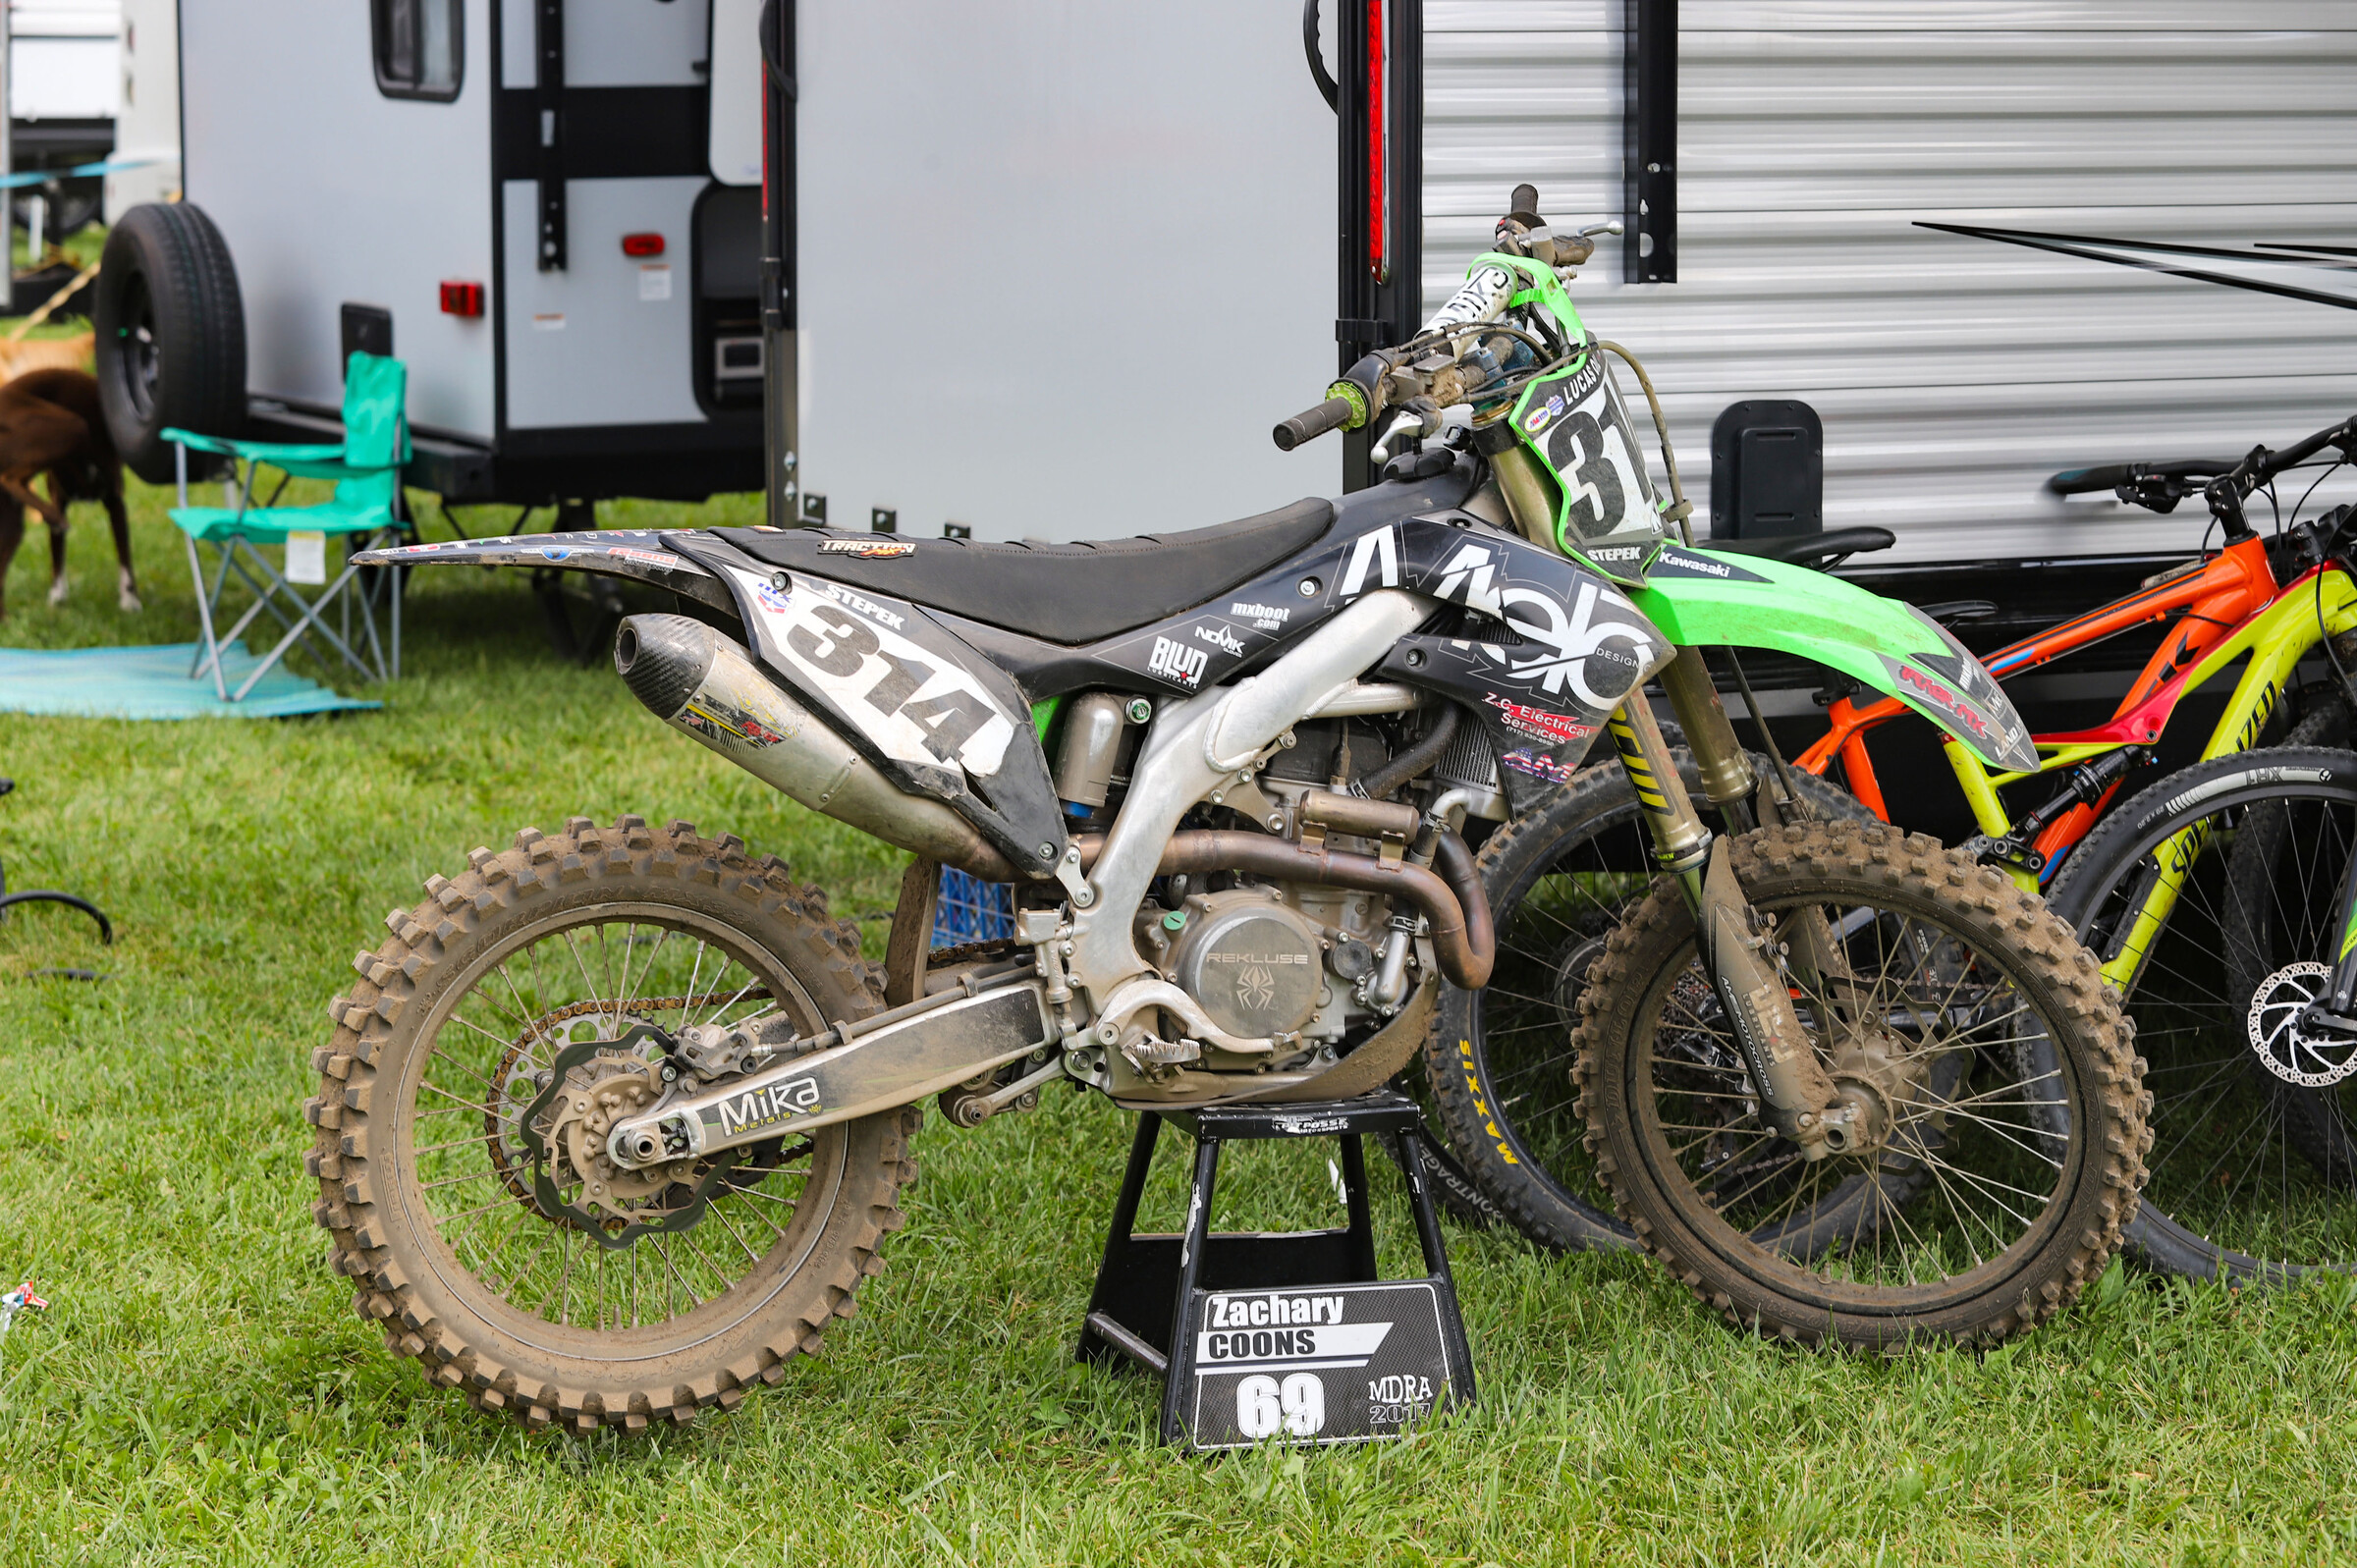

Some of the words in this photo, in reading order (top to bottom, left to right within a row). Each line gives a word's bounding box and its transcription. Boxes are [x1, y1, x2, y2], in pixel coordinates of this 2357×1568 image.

[1563, 367, 1597, 406] LUCAS
[1587, 546, 1641, 562] STEPEK
[1659, 551, 1730, 577] Kawasaki
[825, 583, 905, 631] STEPEK
[1231, 602, 1290, 622] mxboot
[1596, 645, 1641, 670] DESIGN
[787, 604, 997, 765] 314
[1147, 666, 1198, 689] LUBRICANTS
[1501, 712, 1566, 744] Services
[1519, 705, 1590, 738] Electrical
[1206, 952, 1308, 965] REKLUSE
[1742, 993, 1776, 1067] LUBRICANTS
[1735, 1010, 1774, 1097] MOTOCROSS
[718, 1076, 820, 1137] Mika
[1458, 1039, 1518, 1164] MAXXIS
[735, 1111, 792, 1133] Metals
[1211, 1295, 1344, 1328] Zachary
[1209, 1329, 1316, 1361] COONS
[1368, 1375, 1433, 1405] MDRA
[1236, 1374, 1325, 1439] 69
[1369, 1403, 1432, 1425] 2017
